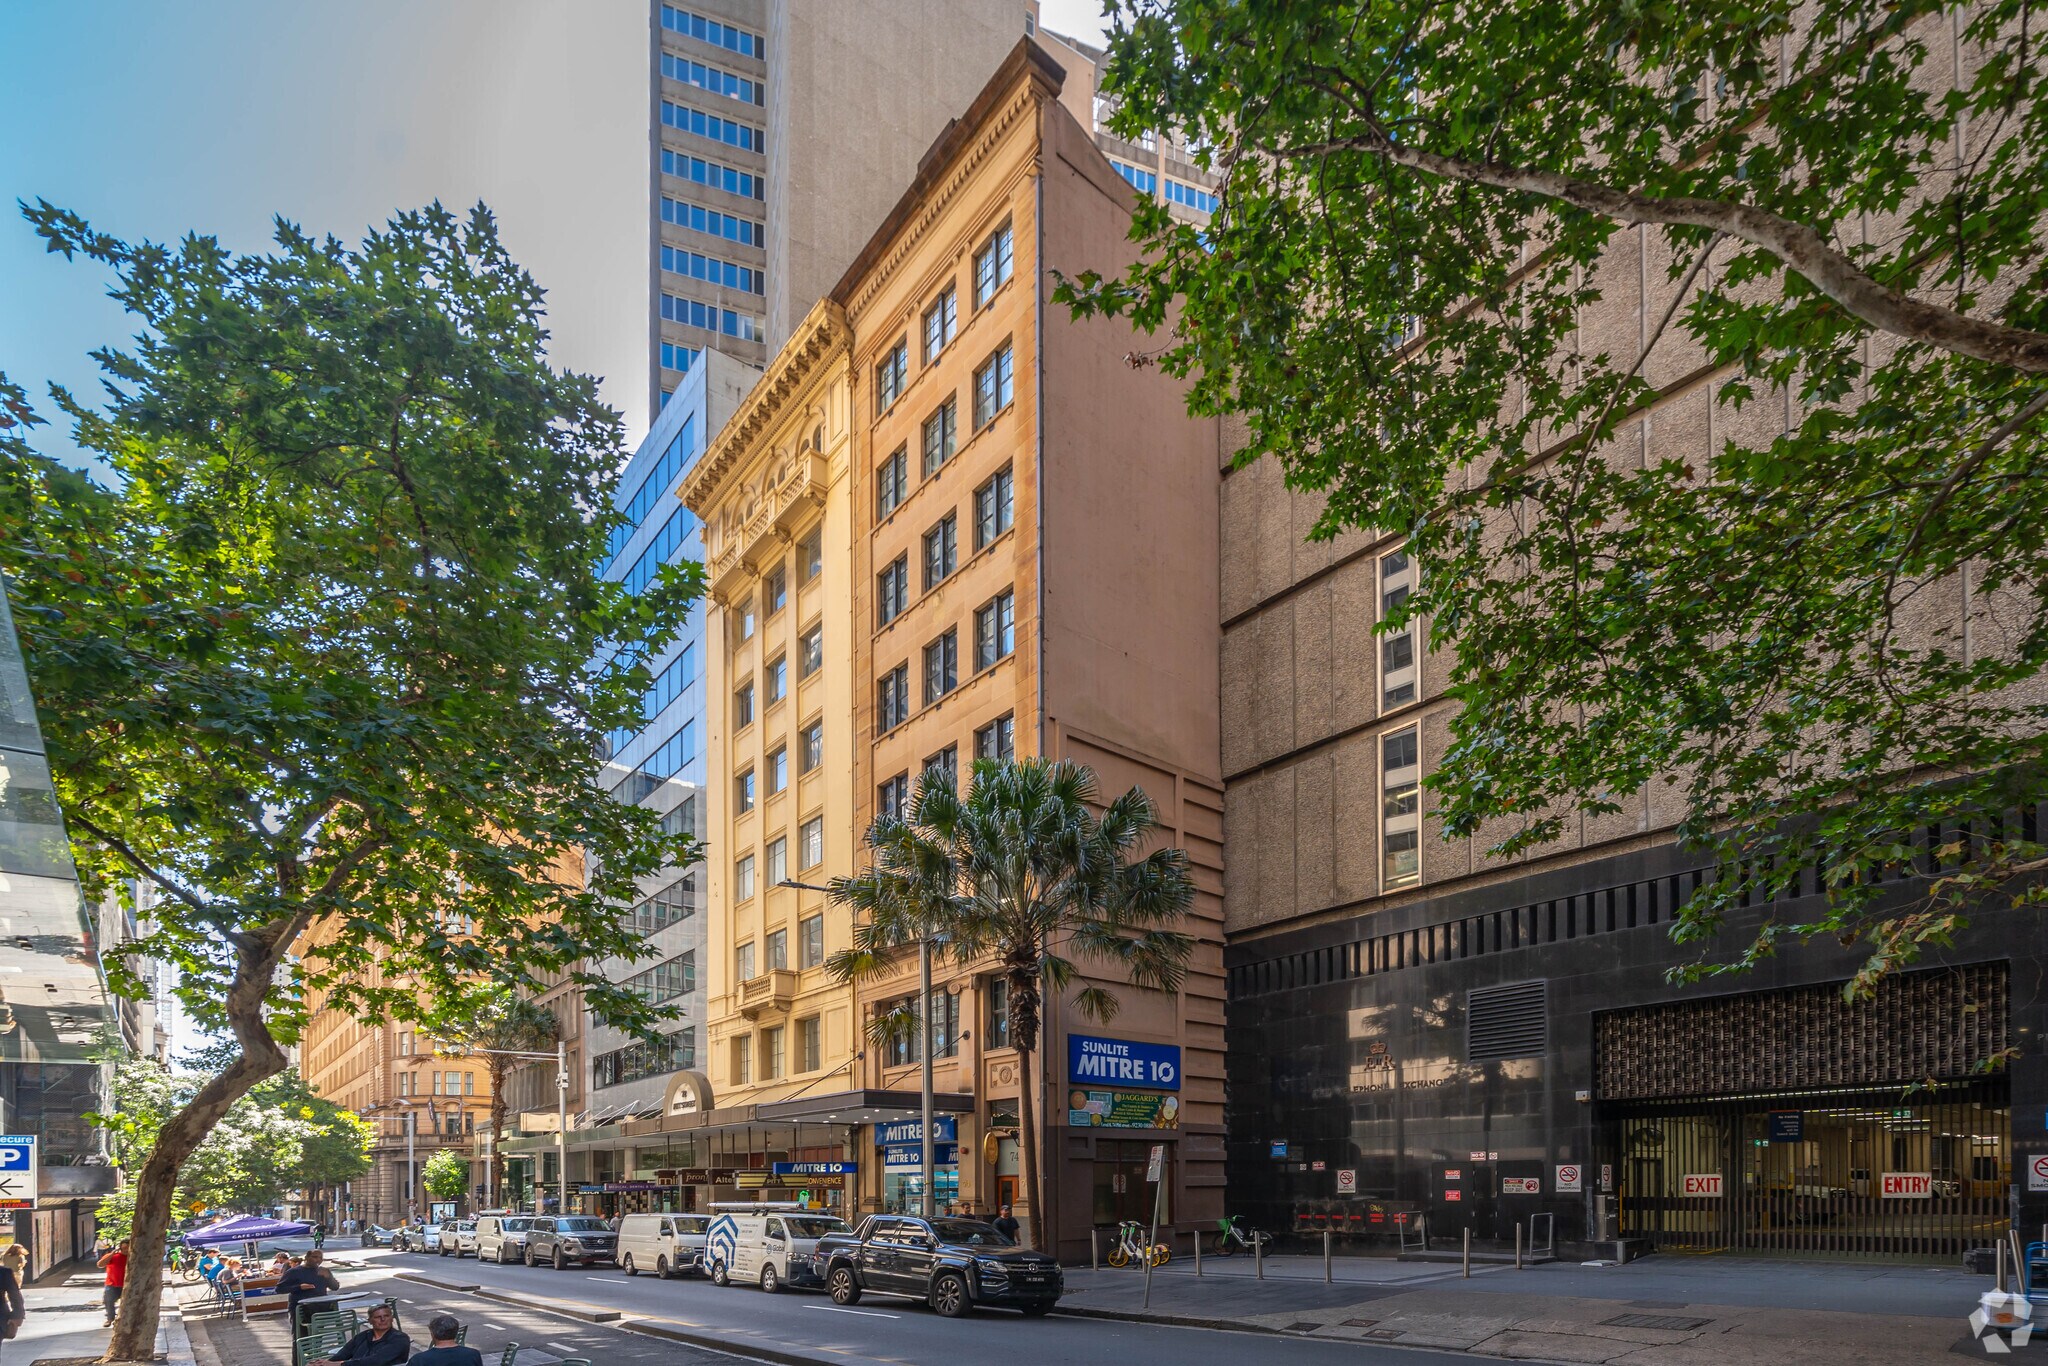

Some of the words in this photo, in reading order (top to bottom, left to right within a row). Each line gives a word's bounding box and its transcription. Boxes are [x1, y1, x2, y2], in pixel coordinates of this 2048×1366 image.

[1082, 1041, 1129, 1056] SUNLITE
[1077, 1054, 1144, 1080] MITRE
[1150, 1061, 1175, 1083] 10
[1121, 1094, 1158, 1102] JAGGARD'S
[886, 1124, 923, 1142] MITRE
[887, 1153, 909, 1163] MITRE
[910, 1153, 919, 1162] 10
[792, 1163, 827, 1173] MITRE
[829, 1163, 843, 1172] 10
[808, 1176, 842, 1185] ONVENIENCE
[1685, 1177, 1721, 1193] EXIT
[1883, 1176, 1931, 1194] ENTRY
